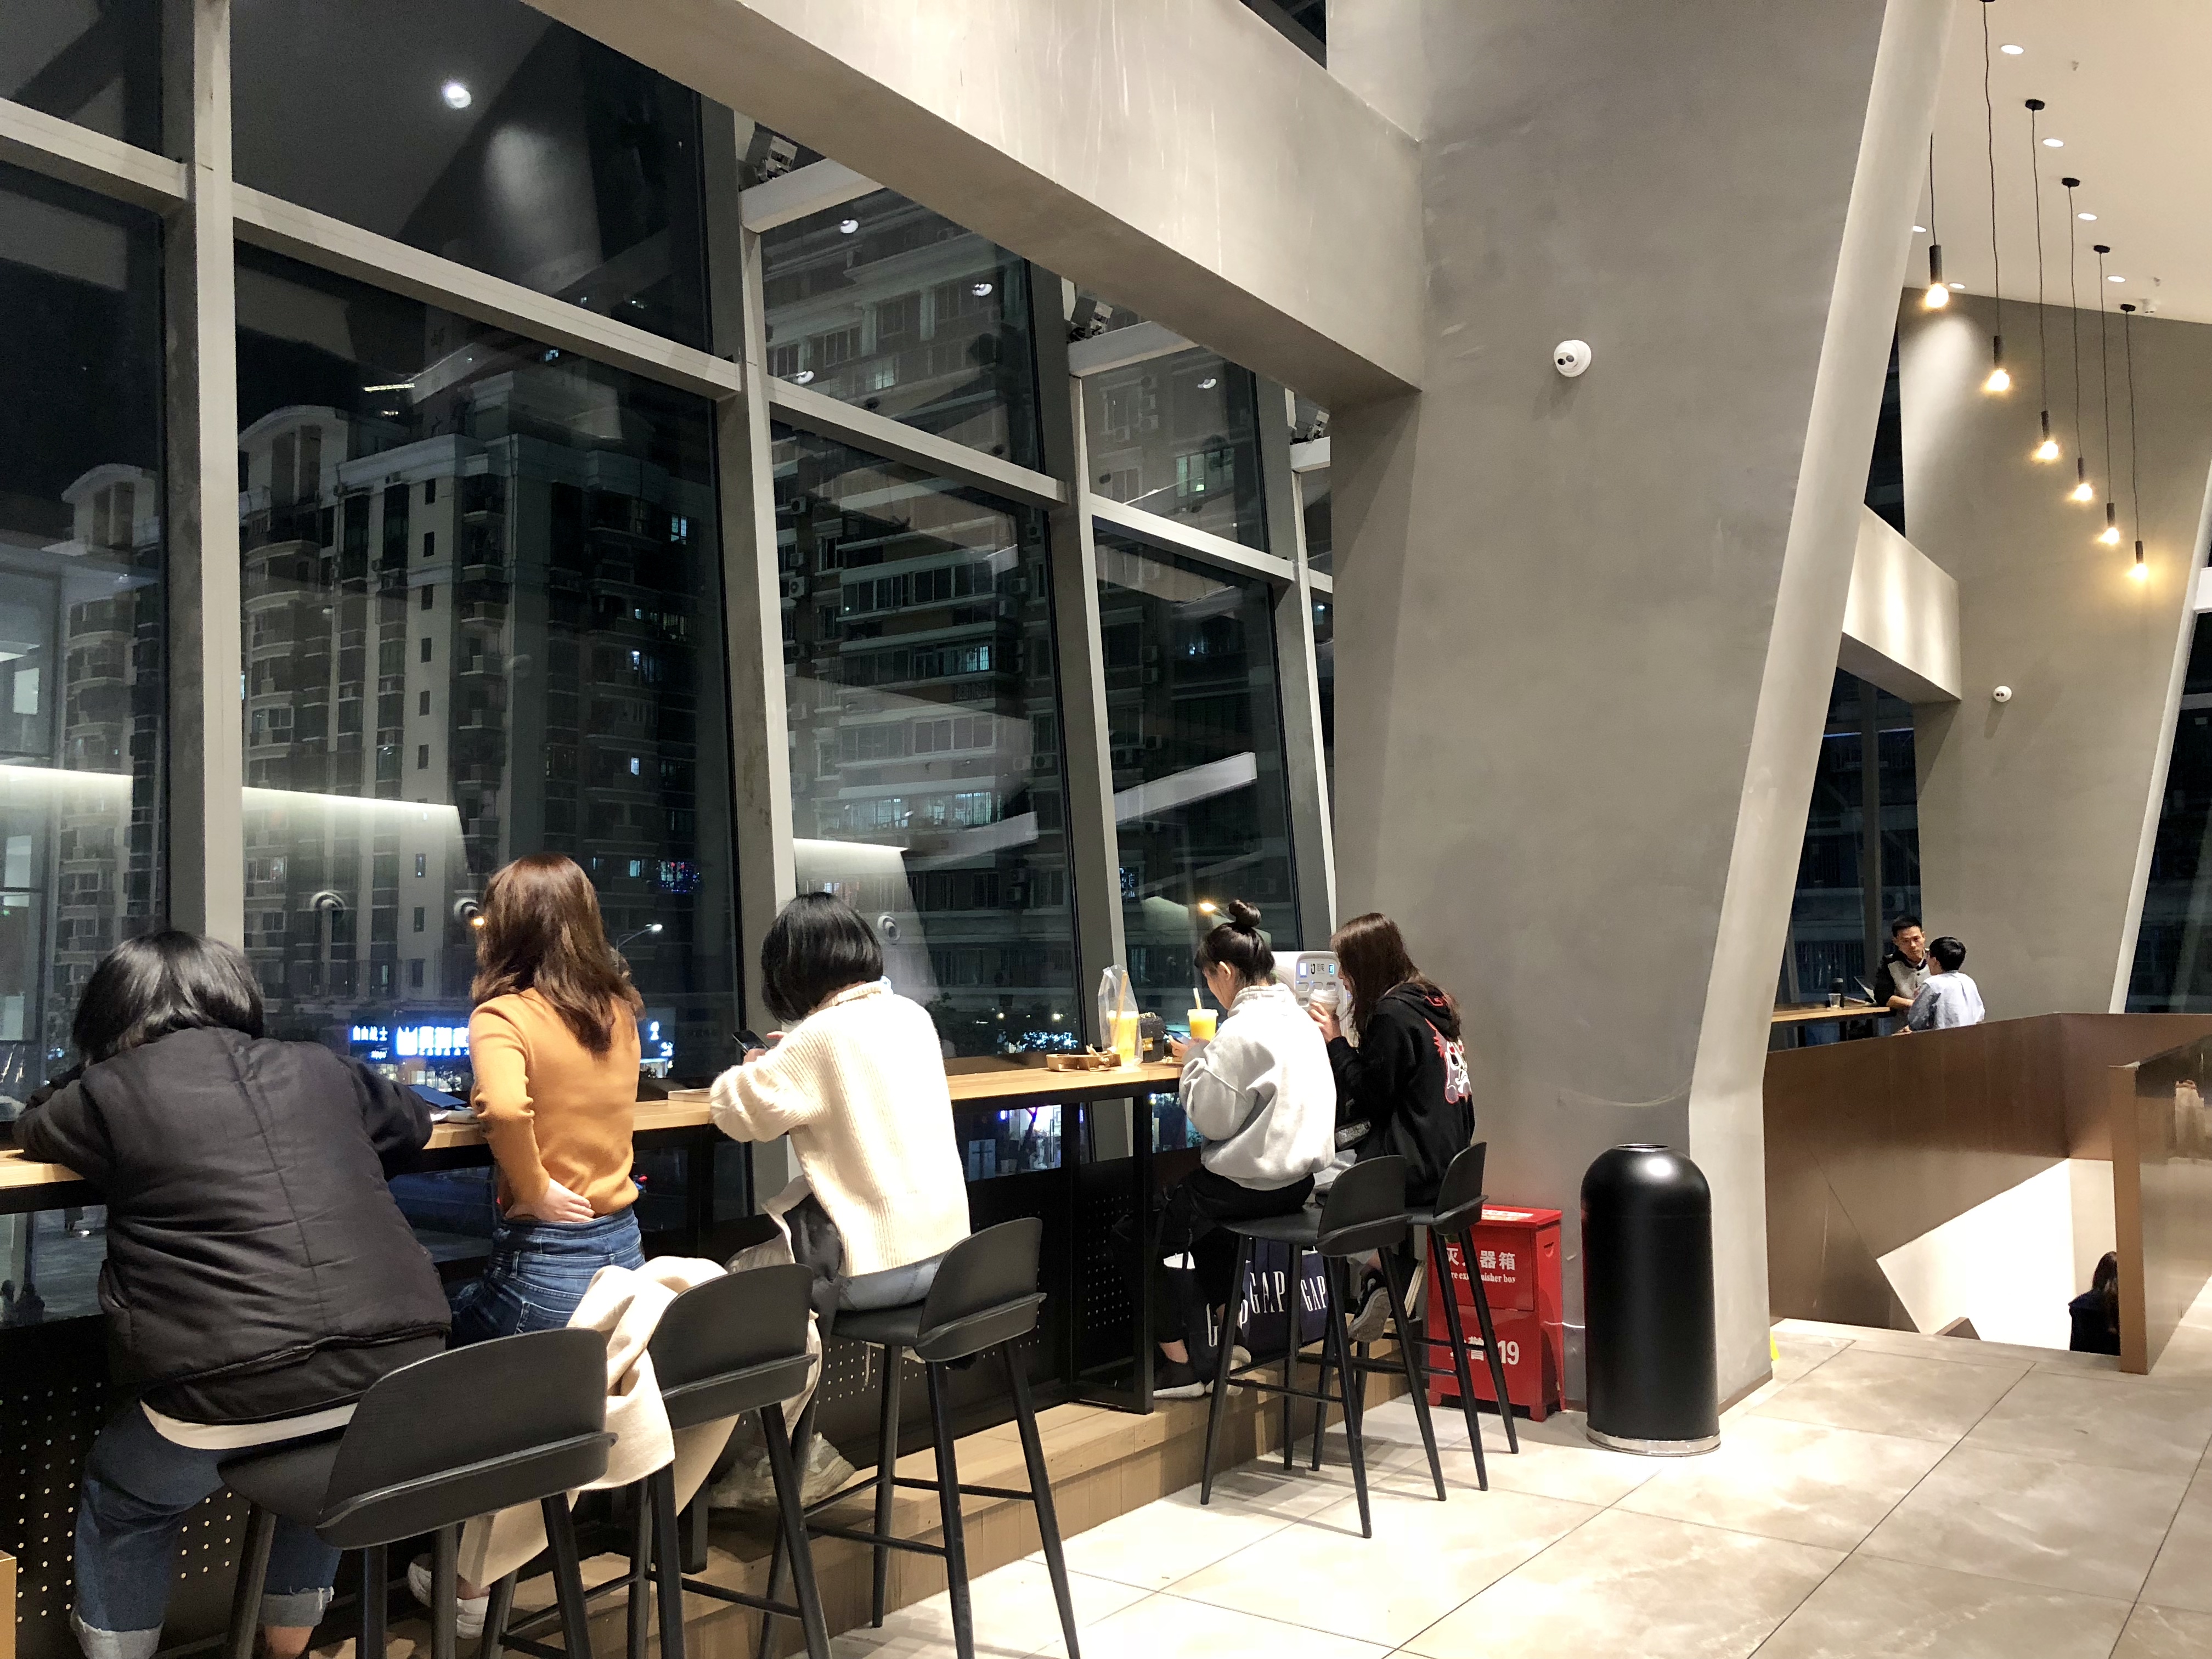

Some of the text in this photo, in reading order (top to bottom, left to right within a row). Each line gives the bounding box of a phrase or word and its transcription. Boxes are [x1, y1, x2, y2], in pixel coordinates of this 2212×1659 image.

[1446, 1247, 1515, 1271] 灭器箱
[1250, 1271, 1286, 1314] GAP
[1300, 1276, 1327, 1312] GAP
[1503, 1274, 1516, 1283] box
[1206, 1299, 1249, 1347] GP
